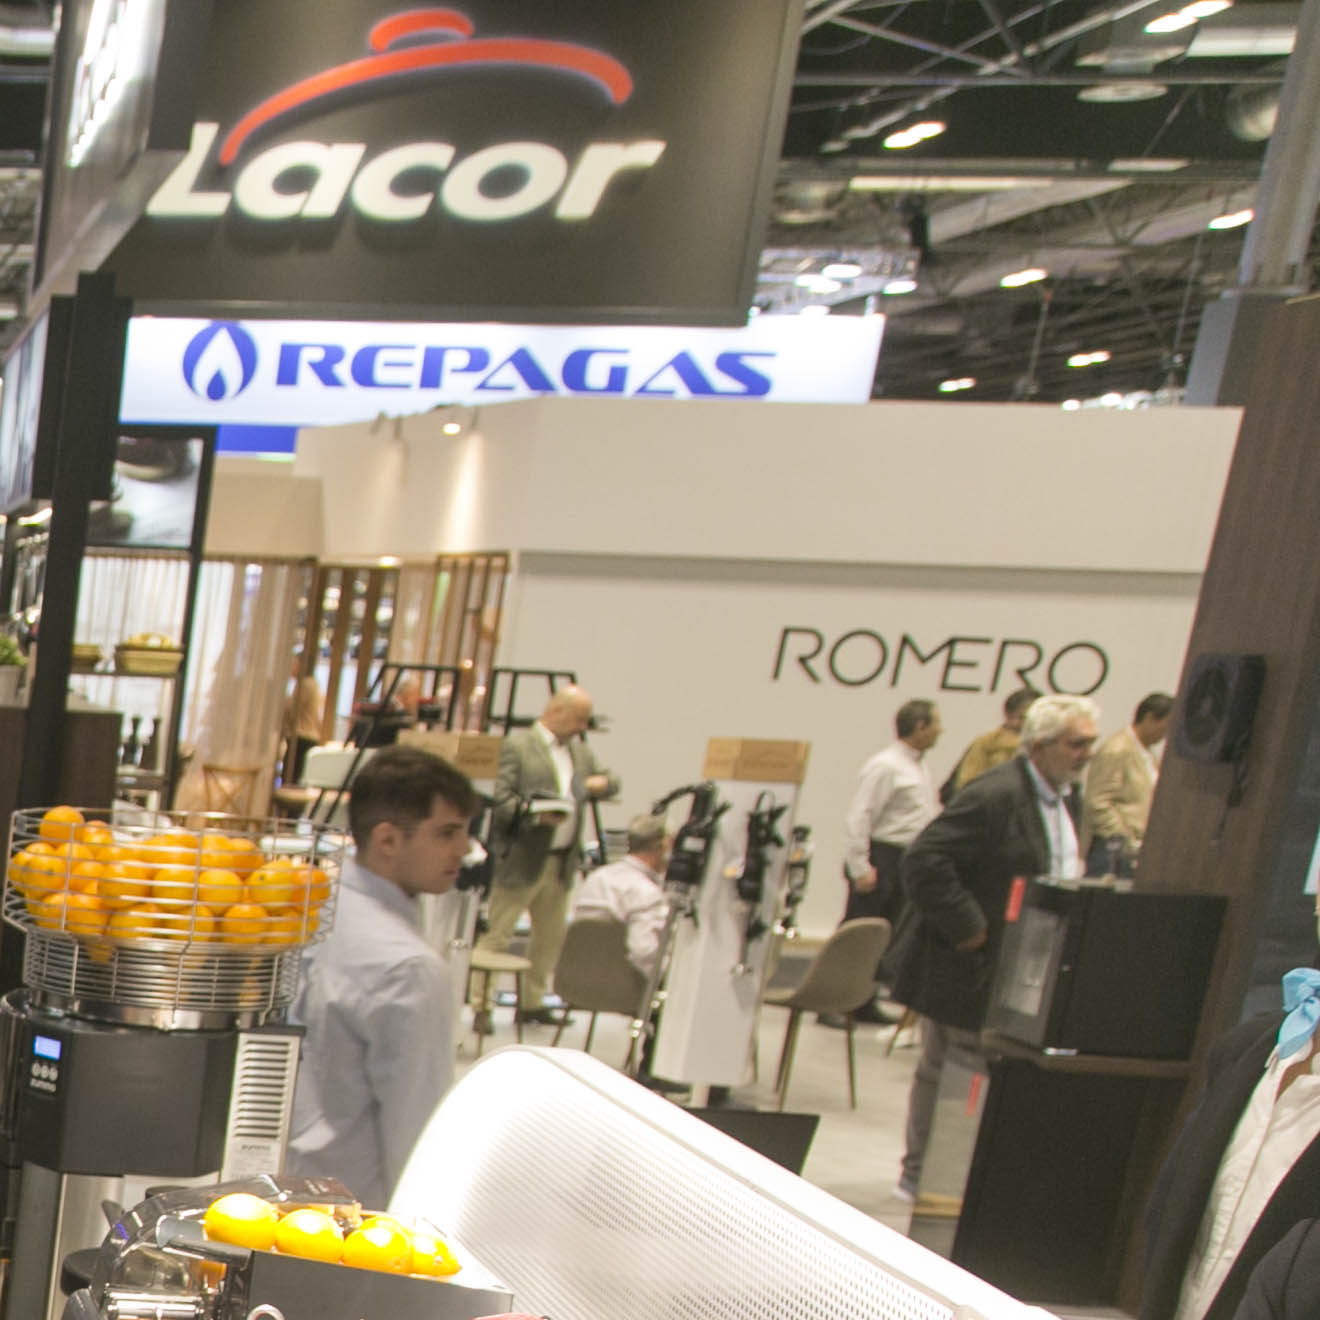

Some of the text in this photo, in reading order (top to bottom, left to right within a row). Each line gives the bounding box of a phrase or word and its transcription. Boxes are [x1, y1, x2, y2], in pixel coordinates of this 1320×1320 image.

[145, 121, 667, 221] Lacor
[275, 343, 778, 397] REPAGAS
[771, 625, 1110, 697] ROMERO
